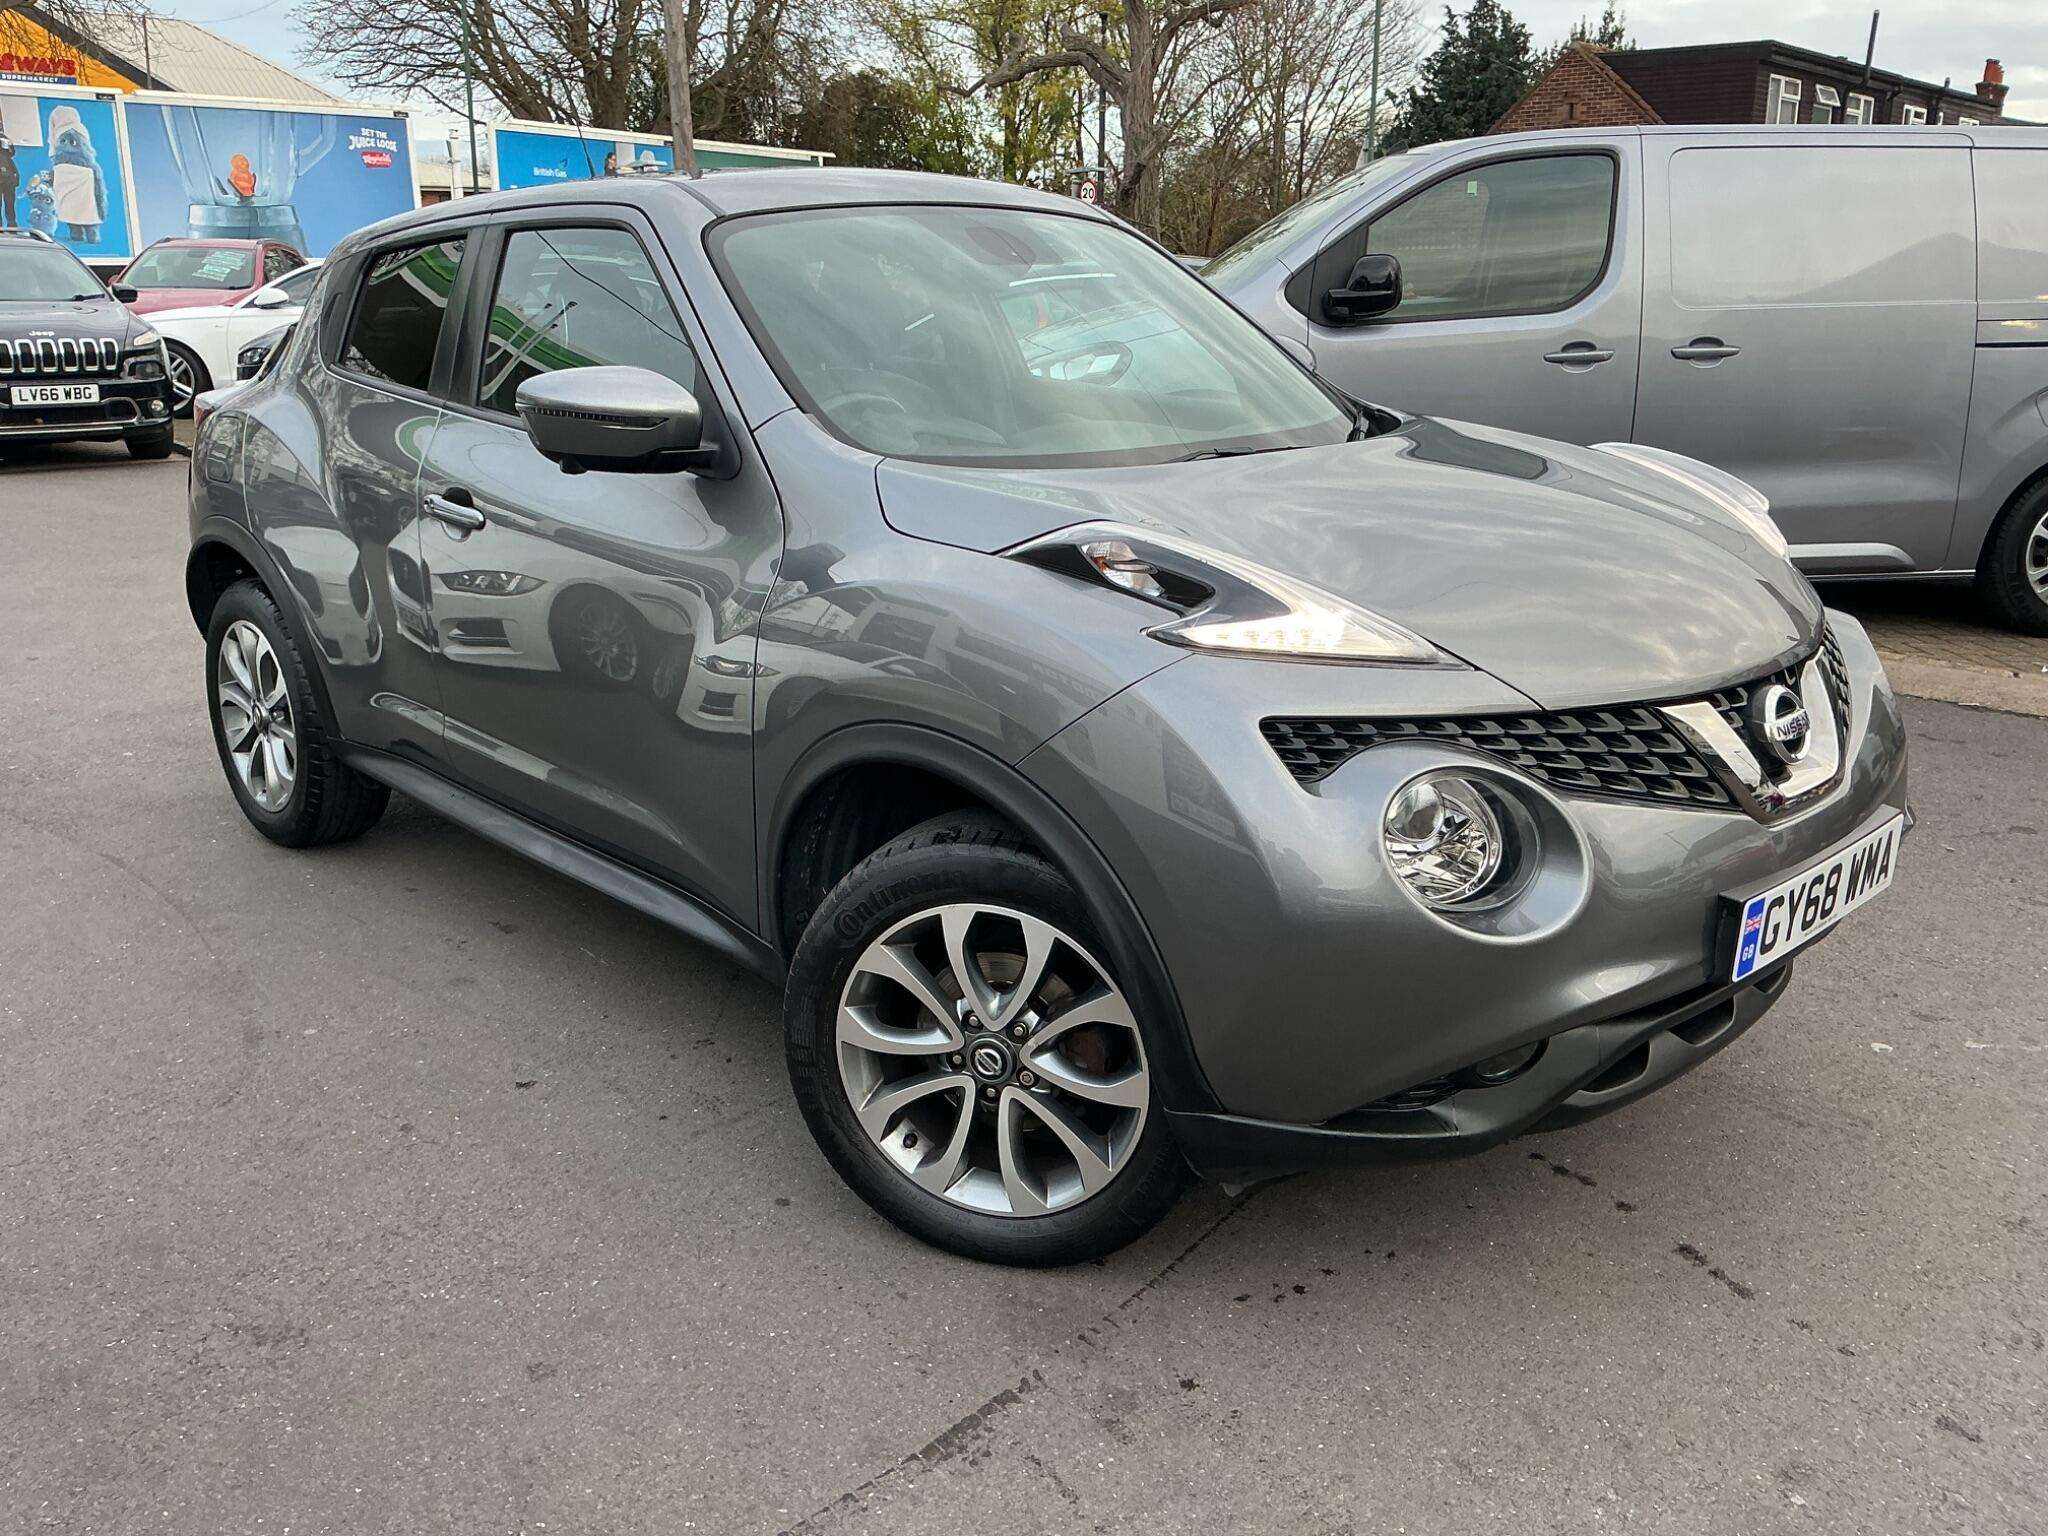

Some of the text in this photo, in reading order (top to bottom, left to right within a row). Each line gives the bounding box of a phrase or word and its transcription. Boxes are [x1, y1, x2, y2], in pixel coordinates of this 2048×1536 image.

[1, 73, 58, 83] SUPERMARKET
[361, 128, 387, 139] SET THE
[348, 135, 398, 152] JUICE LOOSE
[533, 167, 567, 178] British Gas
[1082, 187, 1094, 199] 20
[18, 386, 92, 402] LV66 WBG
[1760, 830, 1894, 956] GY68 WMA
[1742, 944, 1755, 961] GB
